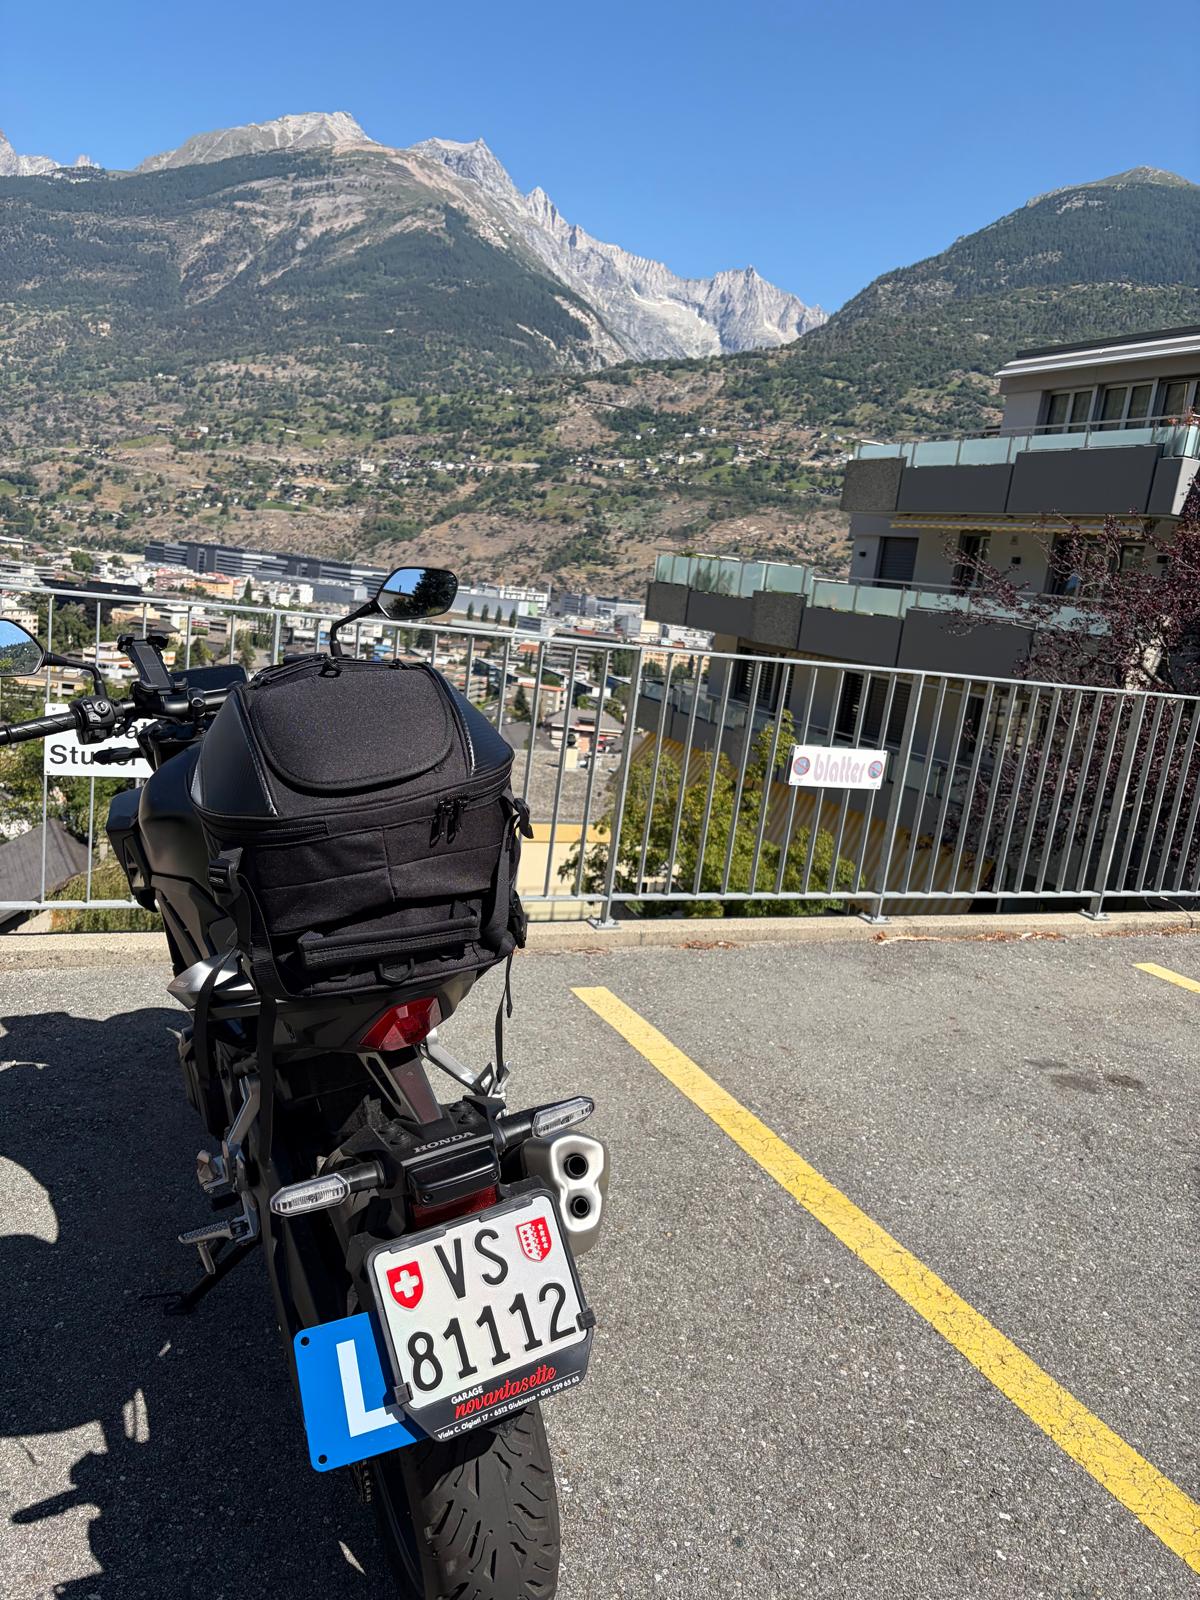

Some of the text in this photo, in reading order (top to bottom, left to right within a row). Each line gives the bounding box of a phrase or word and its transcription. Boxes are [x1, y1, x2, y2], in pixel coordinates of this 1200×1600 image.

[813, 753, 866, 783] blatter
[413, 1131, 476, 1153] HONDA
[433, 1228, 509, 1300] VS
[407, 1282, 577, 1392] 81112
[336, 1338, 405, 1438] L
[437, 1430, 454, 1440] Viale
[461, 1416, 482, 1430] Olgiati
[482, 1413, 489, 1421] 17
[494, 1405, 508, 1416] 6512
[508, 1395, 537, 1410] Giubiasco
[540, 1387, 552, 1396] 091
[552, 1382, 563, 1392] 229
[572, 1375, 580, 1384] 63
[451, 1385, 484, 1404] GARAGE
[455, 1364, 557, 1420] novantasette
